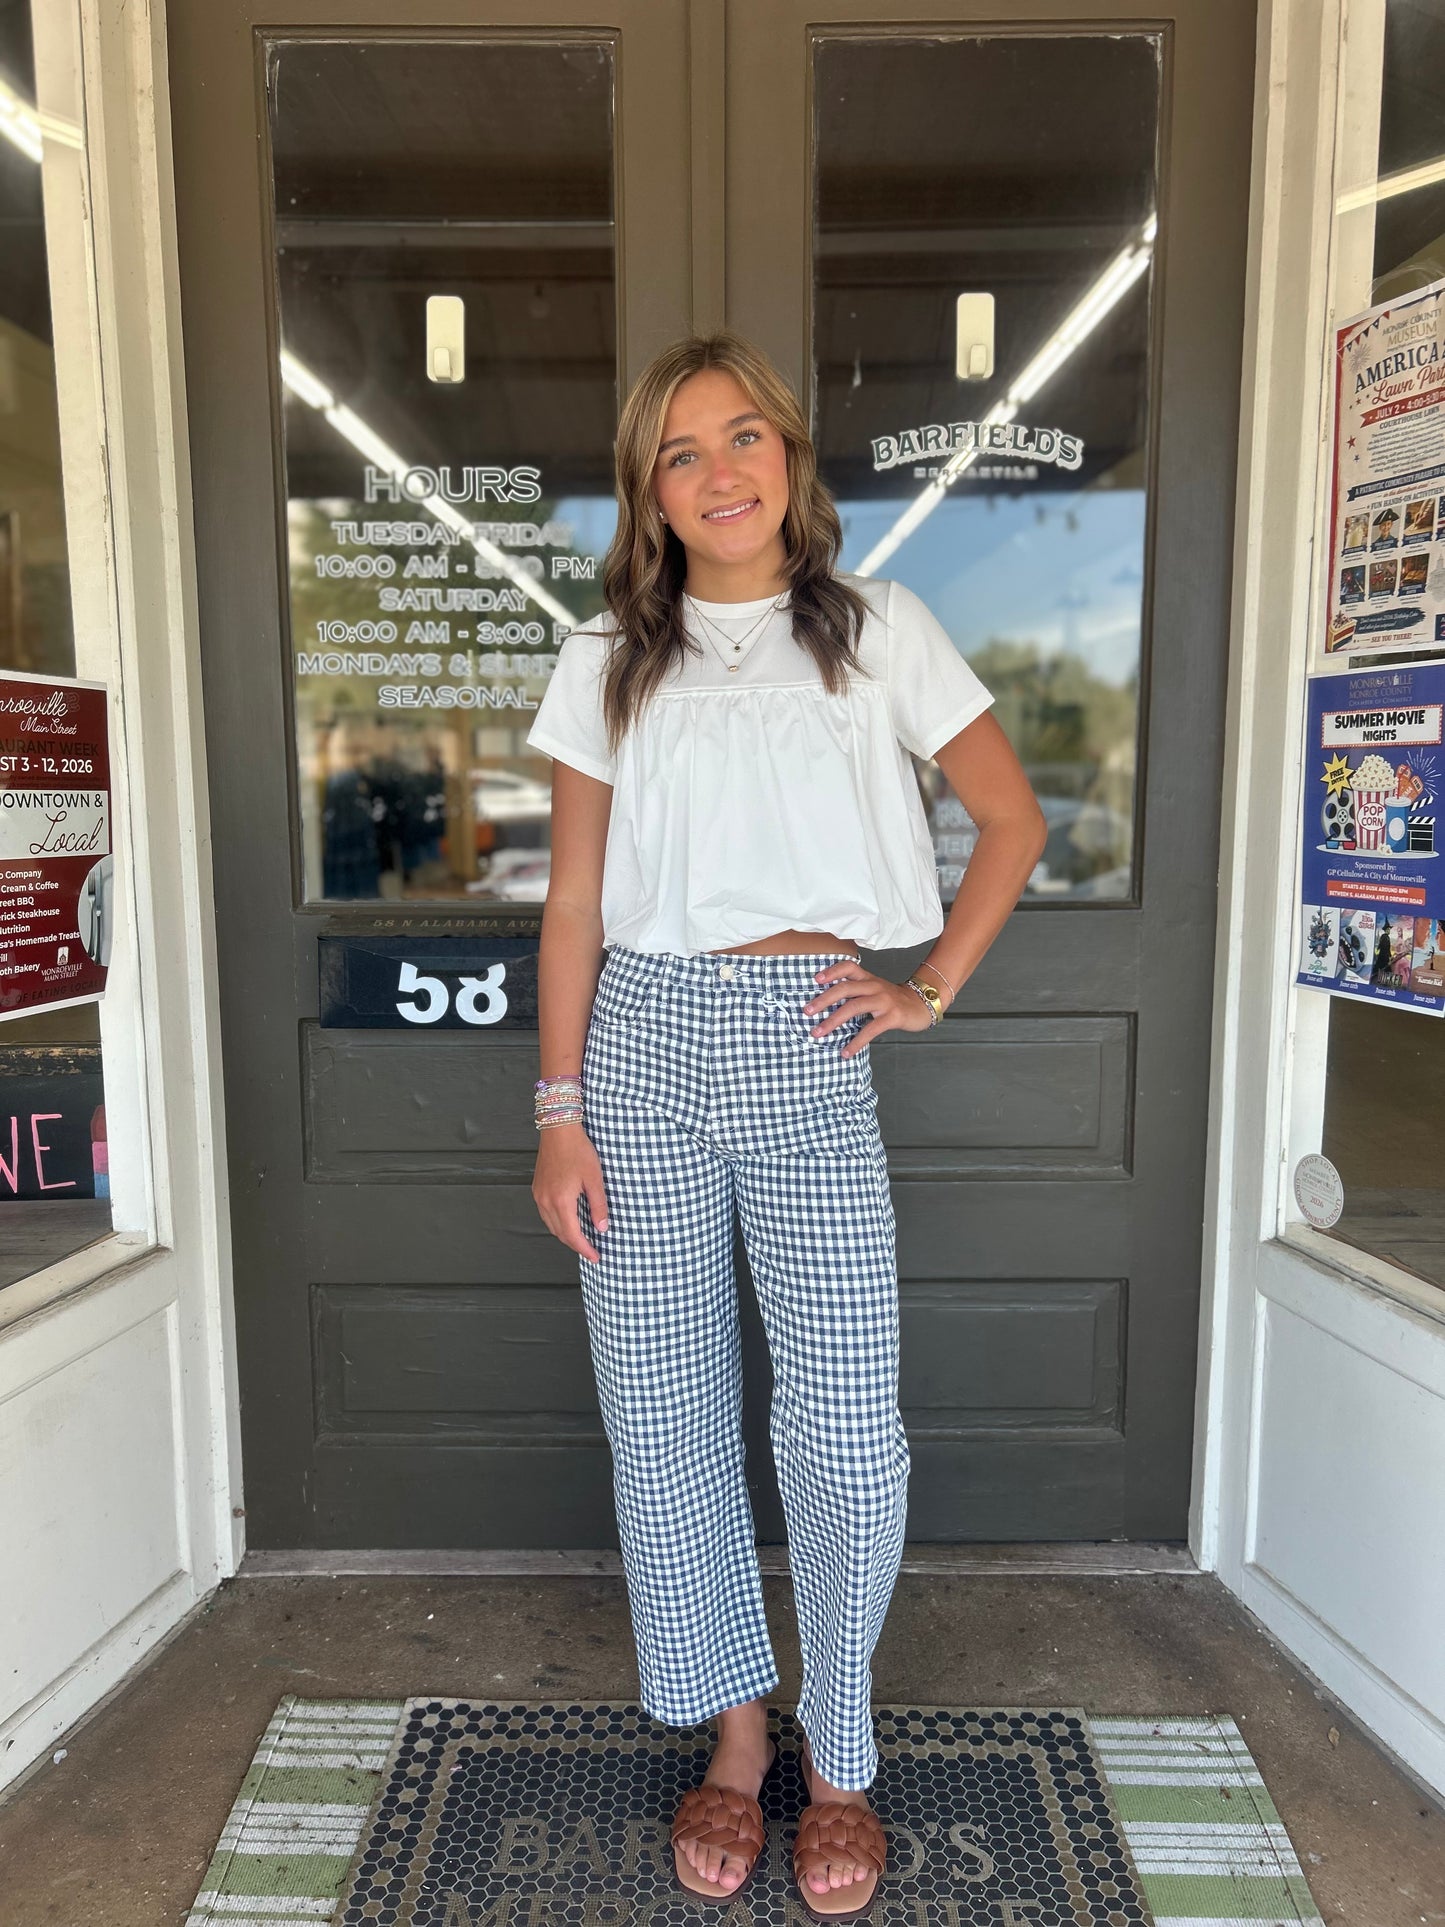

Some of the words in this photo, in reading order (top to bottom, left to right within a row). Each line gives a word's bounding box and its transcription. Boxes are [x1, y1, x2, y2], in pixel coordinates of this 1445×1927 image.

[1388, 321, 1437, 347] MUSEUM
[1354, 341, 1440, 394] AMERICA
[1372, 379, 1415, 405] Lawn
[1417, 364, 1445, 389] Part
[1375, 405, 1393, 419] JULY
[1394, 404, 1400, 414] 2
[870, 421, 1085, 472] BARFIELD'S
[364, 465, 542, 503] HOURS
[315, 554, 396, 577] 10:00
[403, 554, 449, 578] AM
[551, 556, 597, 580] PM
[378, 587, 528, 611] SATURDAY
[317, 621, 397, 645] 10:00
[404, 621, 450, 644] AM
[476, 621, 545, 644] 3:00
[553, 622, 572, 644] P
[298, 653, 442, 677] MONDAYS
[448, 653, 473, 677] &
[479, 653, 559, 678] SUND
[378, 685, 538, 709] SEASONAL
[1380, 686, 1412, 697] COUNTY
[20, 717, 49, 733] Main
[50, 718, 78, 735] Street
[1335, 712, 1385, 729] SUMMER
[1386, 709, 1426, 727] MOVIE
[1362, 729, 1397, 742] NIGHTS
[60, 742, 99, 757] WEEK
[0, 756, 18, 772] ST
[21, 757, 30, 772] 3
[41, 757, 59, 775] 12,
[61, 758, 93, 774] 2026
[1330, 767, 1345, 780] FREE
[0, 793, 90, 808] OWNTOWN
[94, 793, 103, 808] &
[1363, 805, 1384, 816] POP
[1361, 817, 1384, 827] CORN
[30, 811, 104, 854] Local
[1355, 861, 1386, 871] Sponsored
[1387, 863, 1397, 872] by:
[5, 870, 42, 880] Company
[1327, 868, 1337, 876] GP
[1337, 869, 1364, 879] Cellulose
[1369, 872, 1382, 882] City
[1382, 873, 1390, 881] of
[1390, 874, 1427, 884] Monroeville
[1, 884, 27, 893] Cream
[28, 882, 34, 891] &
[35, 881, 59, 891] Coffee
[17, 896, 35, 906] BBQ
[1354, 892, 1376, 900] ALABAMA
[1409, 897, 1423, 905] ROAD
[0, 911, 16, 922] rick
[17, 908, 60, 920] Steakhouse
[372, 919, 396, 928] 58
[402, 919, 413, 928] N
[420, 919, 499, 928] ALABAMA
[15, 934, 58, 947] Homemade
[58, 931, 80, 941] Treats
[14, 963, 41, 975] Bakery
[32, 986, 67, 1000] EATING
[395, 961, 508, 1025] 58
[1375, 987, 1386, 995] June
[1413, 994, 1425, 1002] June
[490, 1815, 994, 1883] BARED'S
